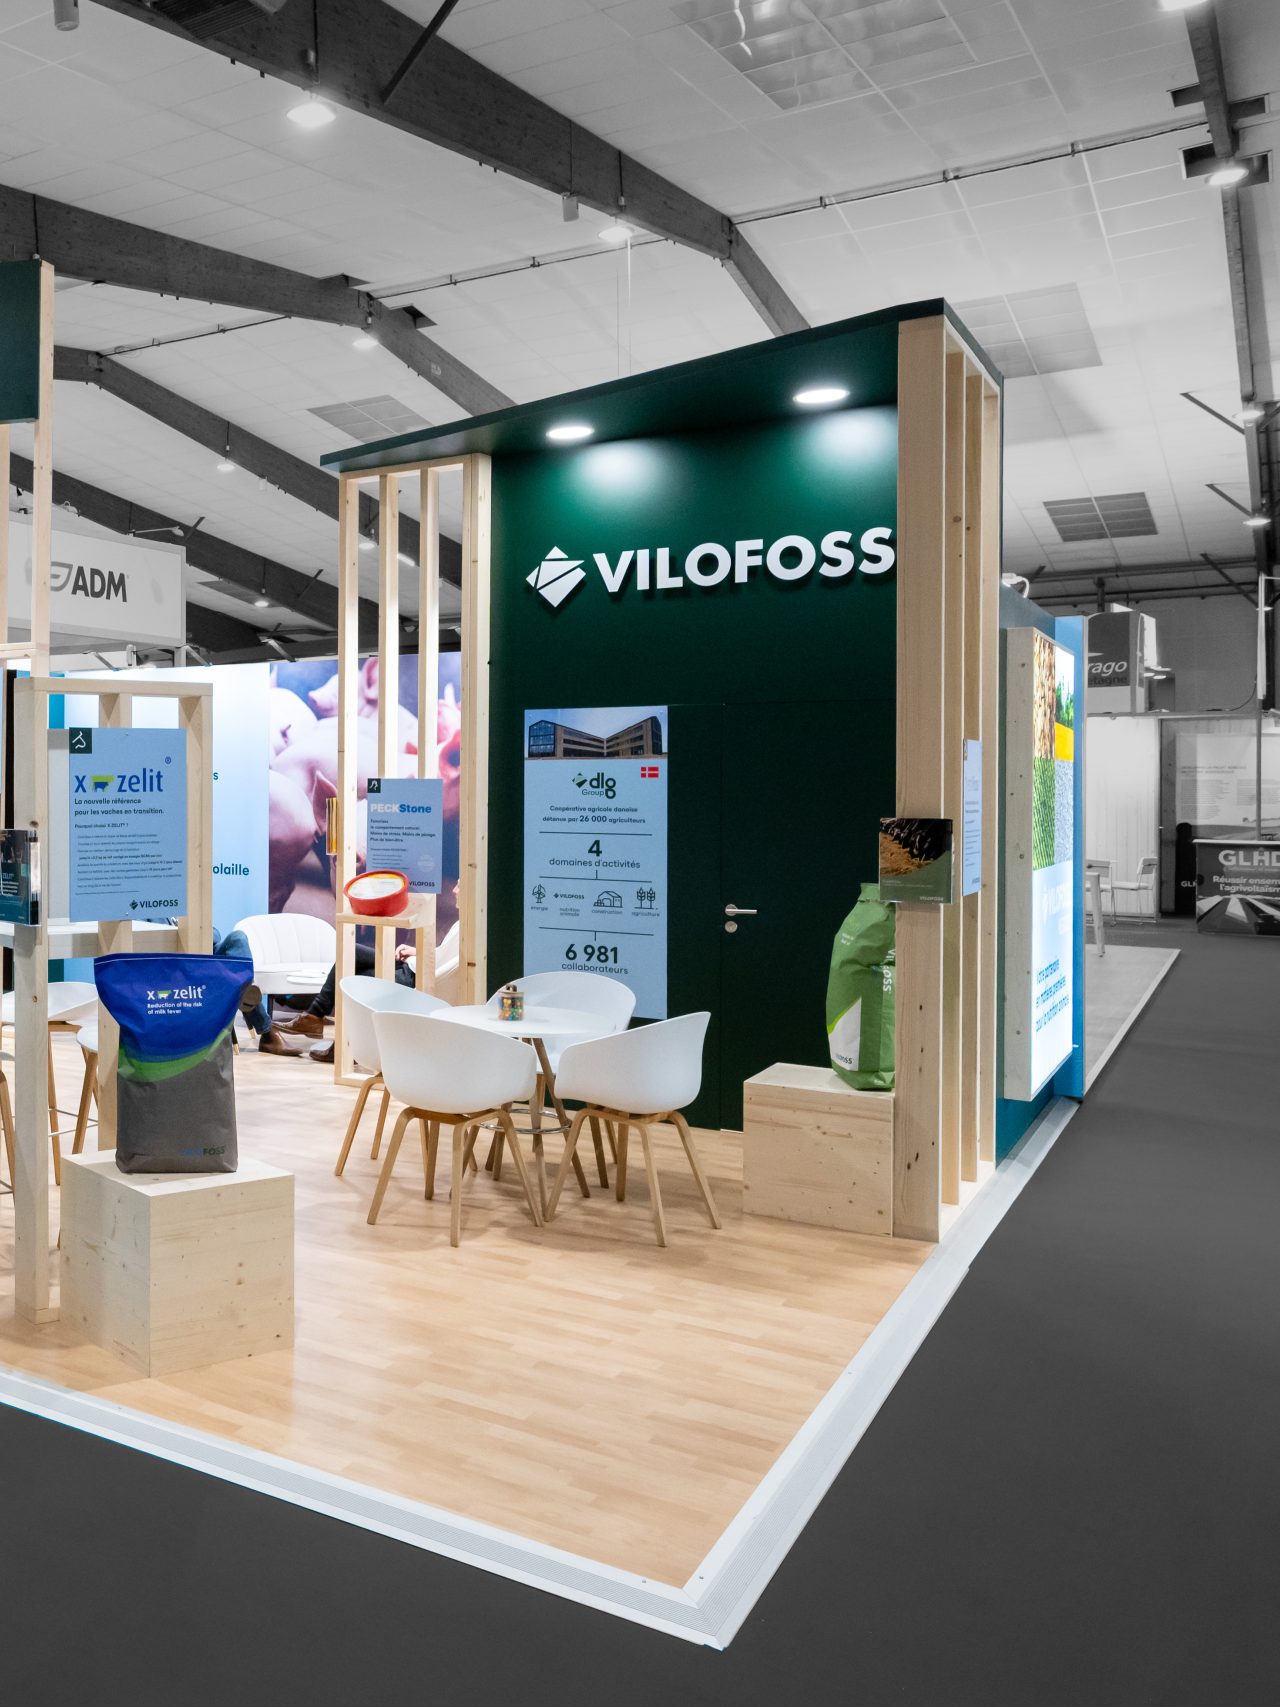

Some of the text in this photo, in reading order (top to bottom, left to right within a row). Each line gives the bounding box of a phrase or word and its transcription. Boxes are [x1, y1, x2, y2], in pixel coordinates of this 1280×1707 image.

[593, 526, 895, 593] VILOFOSS
[71, 566, 127, 602] ADM
[1088, 661, 1127, 676] rago
[117, 768, 164, 792] zelit
[589, 772, 616, 799] dlg
[582, 789, 604, 797] Group
[370, 803, 432, 813] PECKStone
[549, 805, 586, 813] Coopérative
[580, 815, 589, 823] 26
[591, 815, 607, 823] 000
[588, 839, 602, 857] 4
[212, 863, 249, 876] olaille
[549, 858, 641, 869] domaines d'activités
[1213, 875, 1248, 883] Réussir
[140, 899, 178, 908] VILOFOSS
[565, 943, 618, 964] 6 981
[561, 962, 628, 974] collaborateurs
[173, 985, 203, 999] zelit
